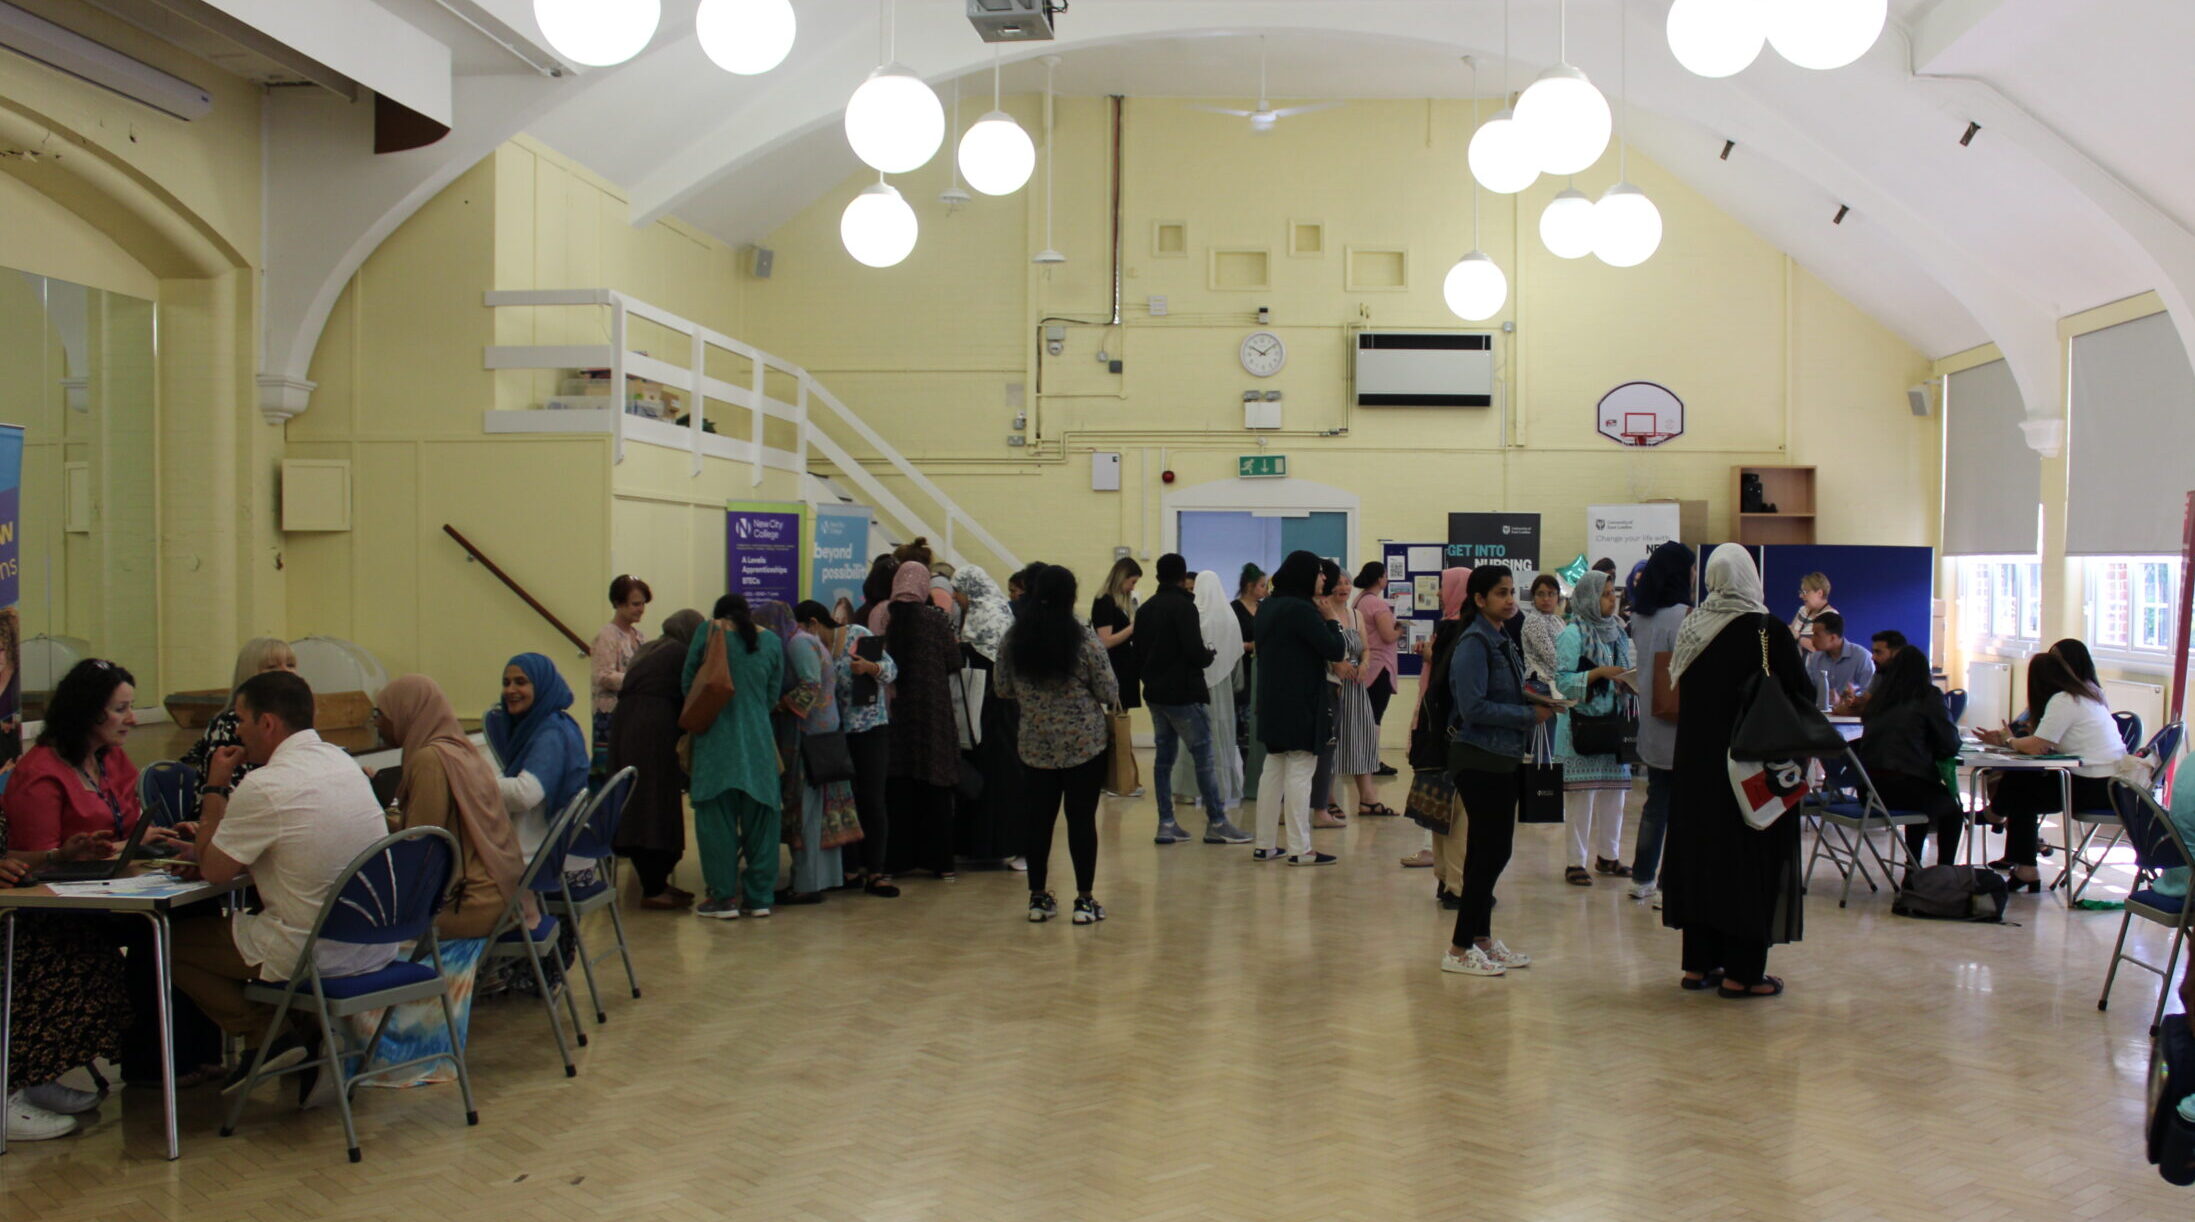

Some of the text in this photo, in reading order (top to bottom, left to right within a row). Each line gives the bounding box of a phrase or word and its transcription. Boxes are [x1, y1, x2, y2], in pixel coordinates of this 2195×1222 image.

[753, 519, 783, 530] New City
[753, 529, 779, 541] College
[1595, 534, 1623, 543] Change
[1624, 536, 1640, 544] your
[1642, 534, 1653, 542] life
[814, 542, 853, 563] beyond
[1447, 544, 1505, 557] GET INTO
